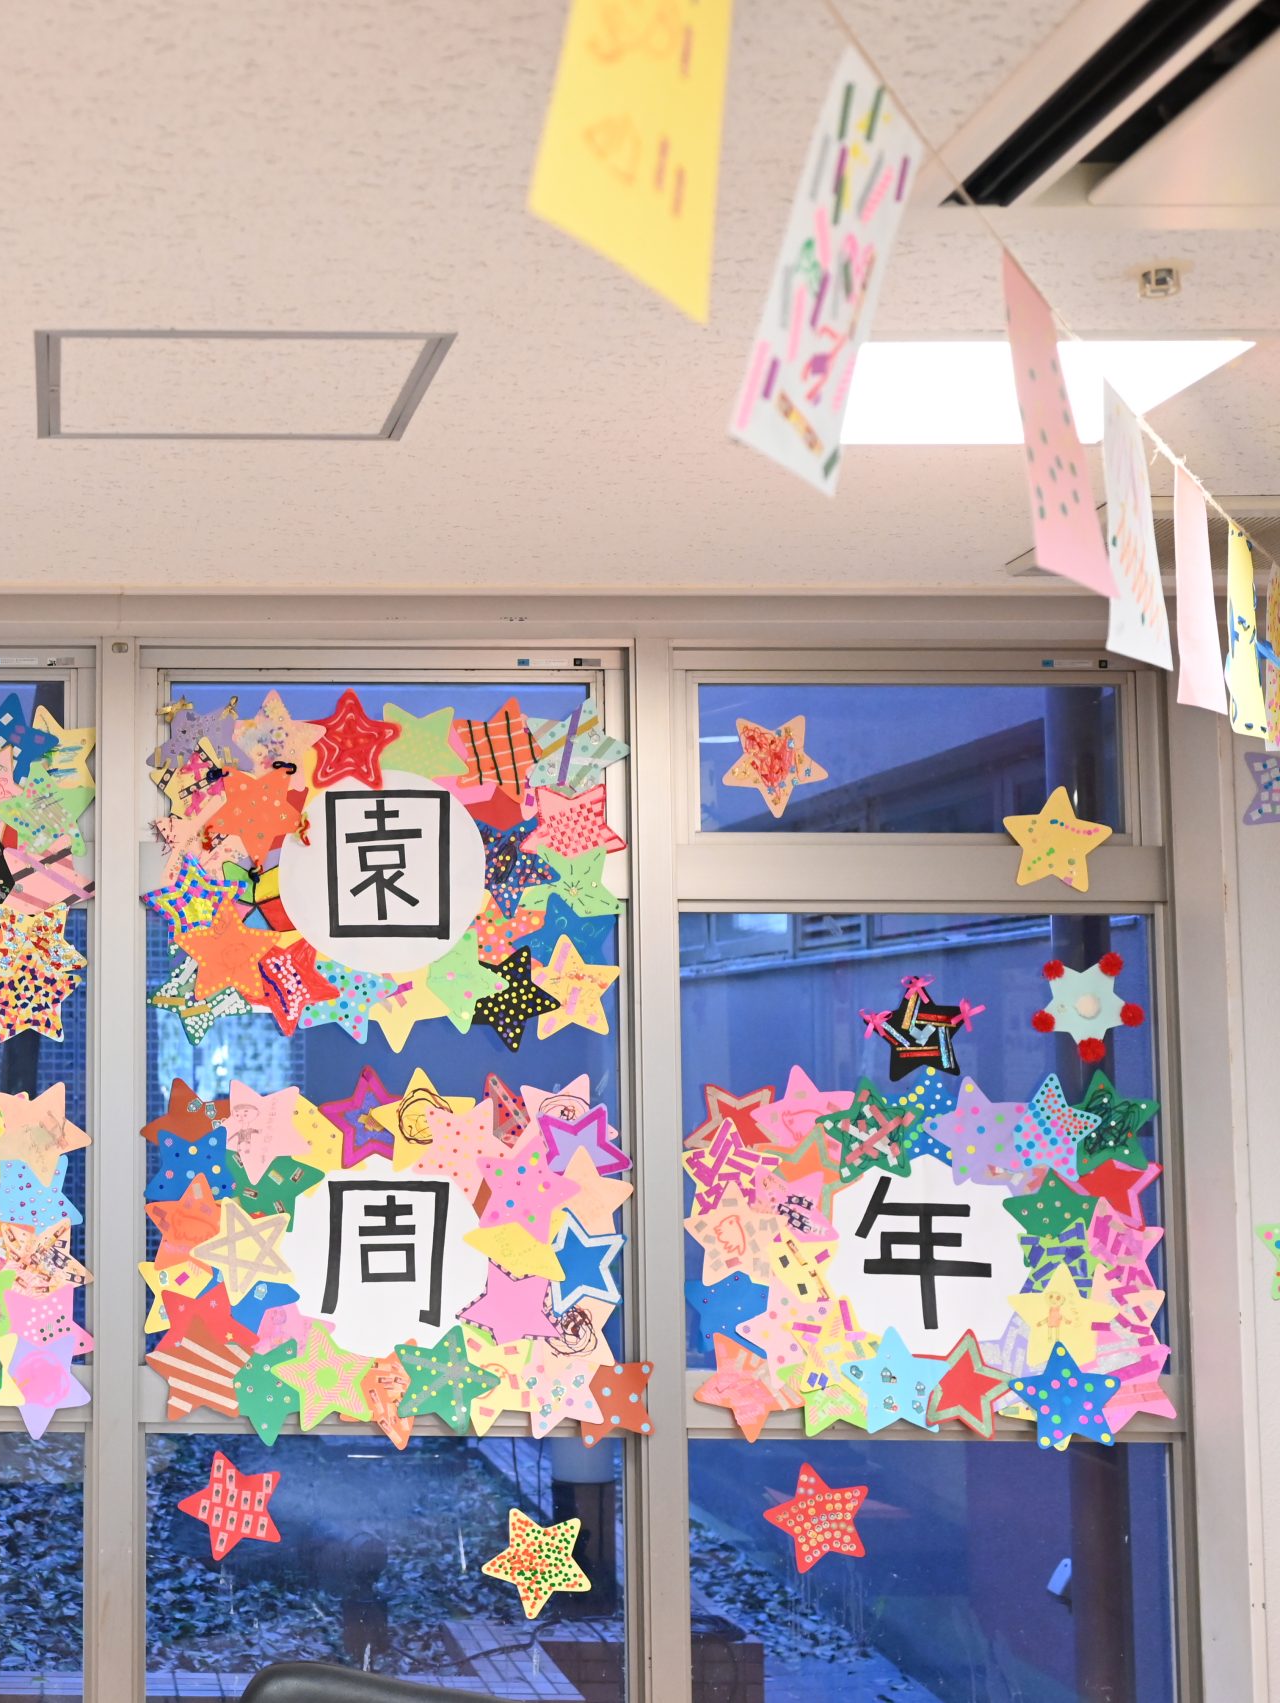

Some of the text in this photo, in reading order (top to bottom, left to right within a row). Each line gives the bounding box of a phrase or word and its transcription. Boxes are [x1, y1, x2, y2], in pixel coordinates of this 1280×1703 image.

[325, 789, 451, 941] 園
[320, 1180, 450, 1328] 周
[854, 1175, 992, 1330] 年
